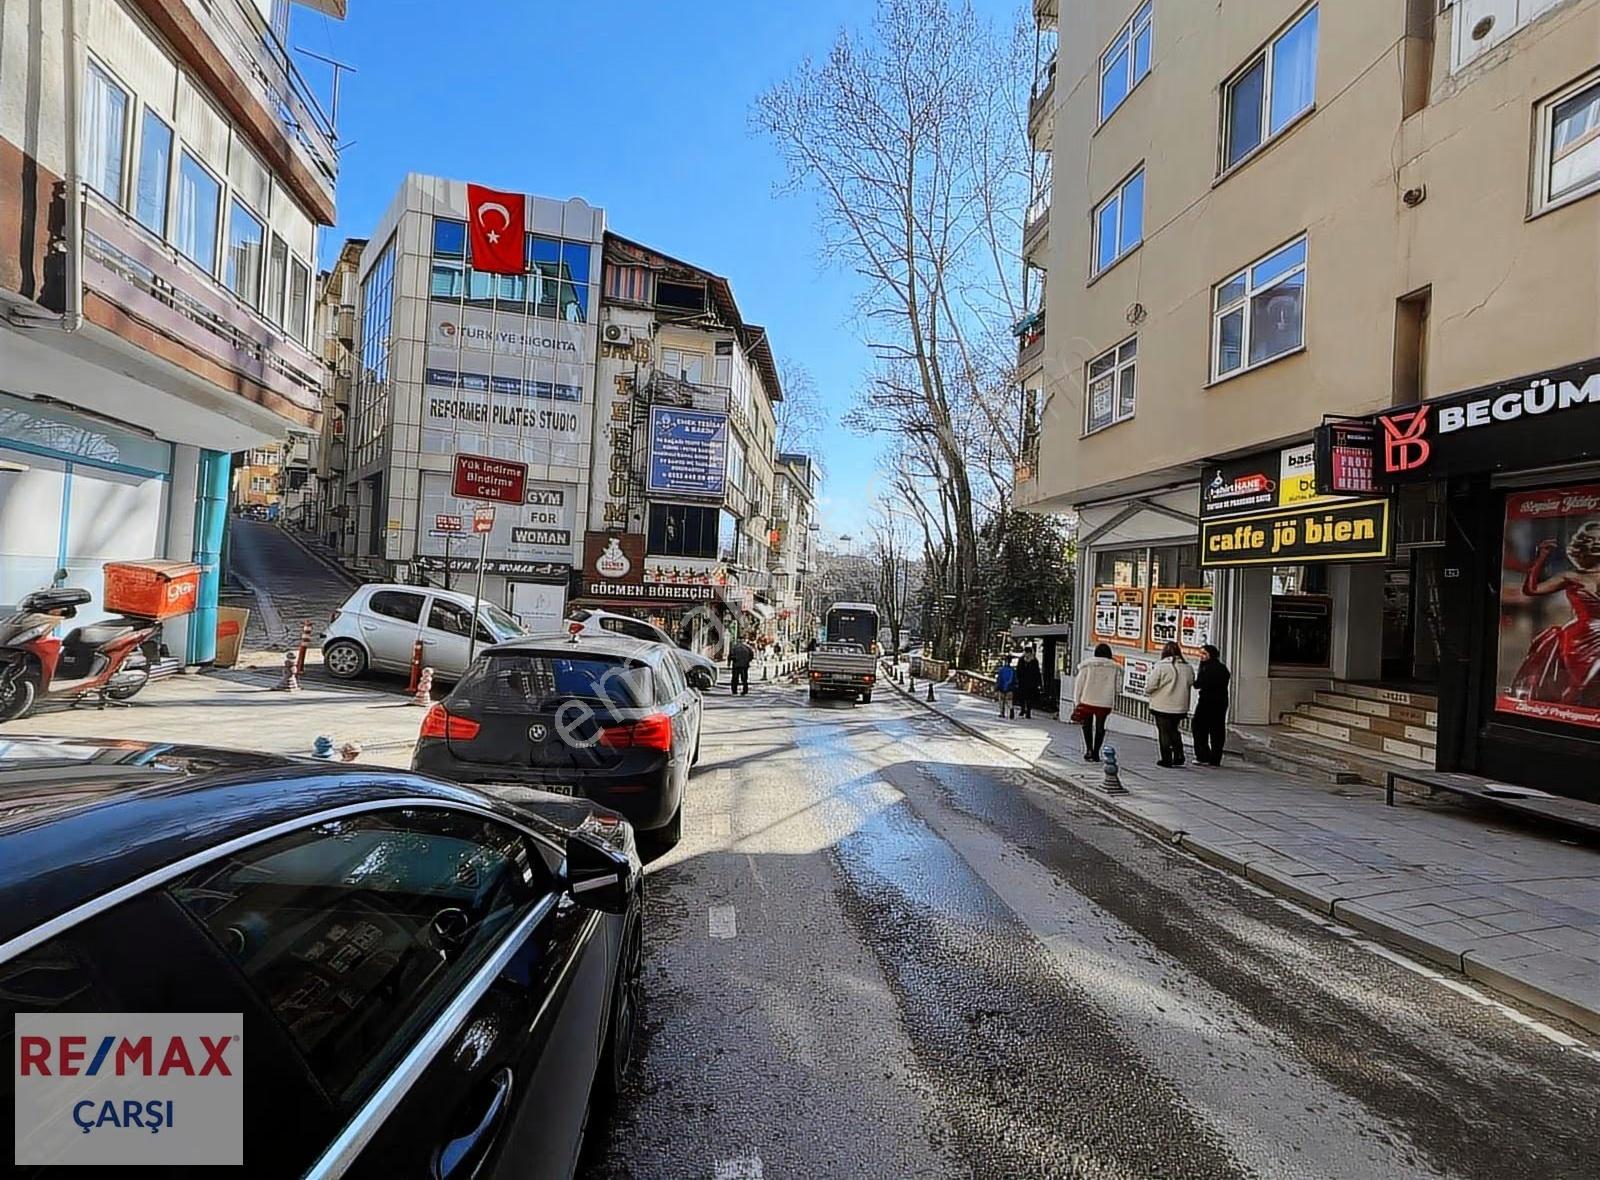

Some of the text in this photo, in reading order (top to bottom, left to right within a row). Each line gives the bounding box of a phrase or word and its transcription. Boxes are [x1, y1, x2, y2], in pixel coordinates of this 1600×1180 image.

[1439, 374, 1600, 434] BEGÜM
[430, 398, 577, 432] REFORMER PILATES STUDIO
[460, 458, 480, 471] Yük
[528, 491, 561, 505] GYM
[530, 512, 556, 524] FOR
[515, 530, 566, 544] WOMAN
[1209, 515, 1375, 553] caffe jö bien
[450, 560, 471, 570] GYM
